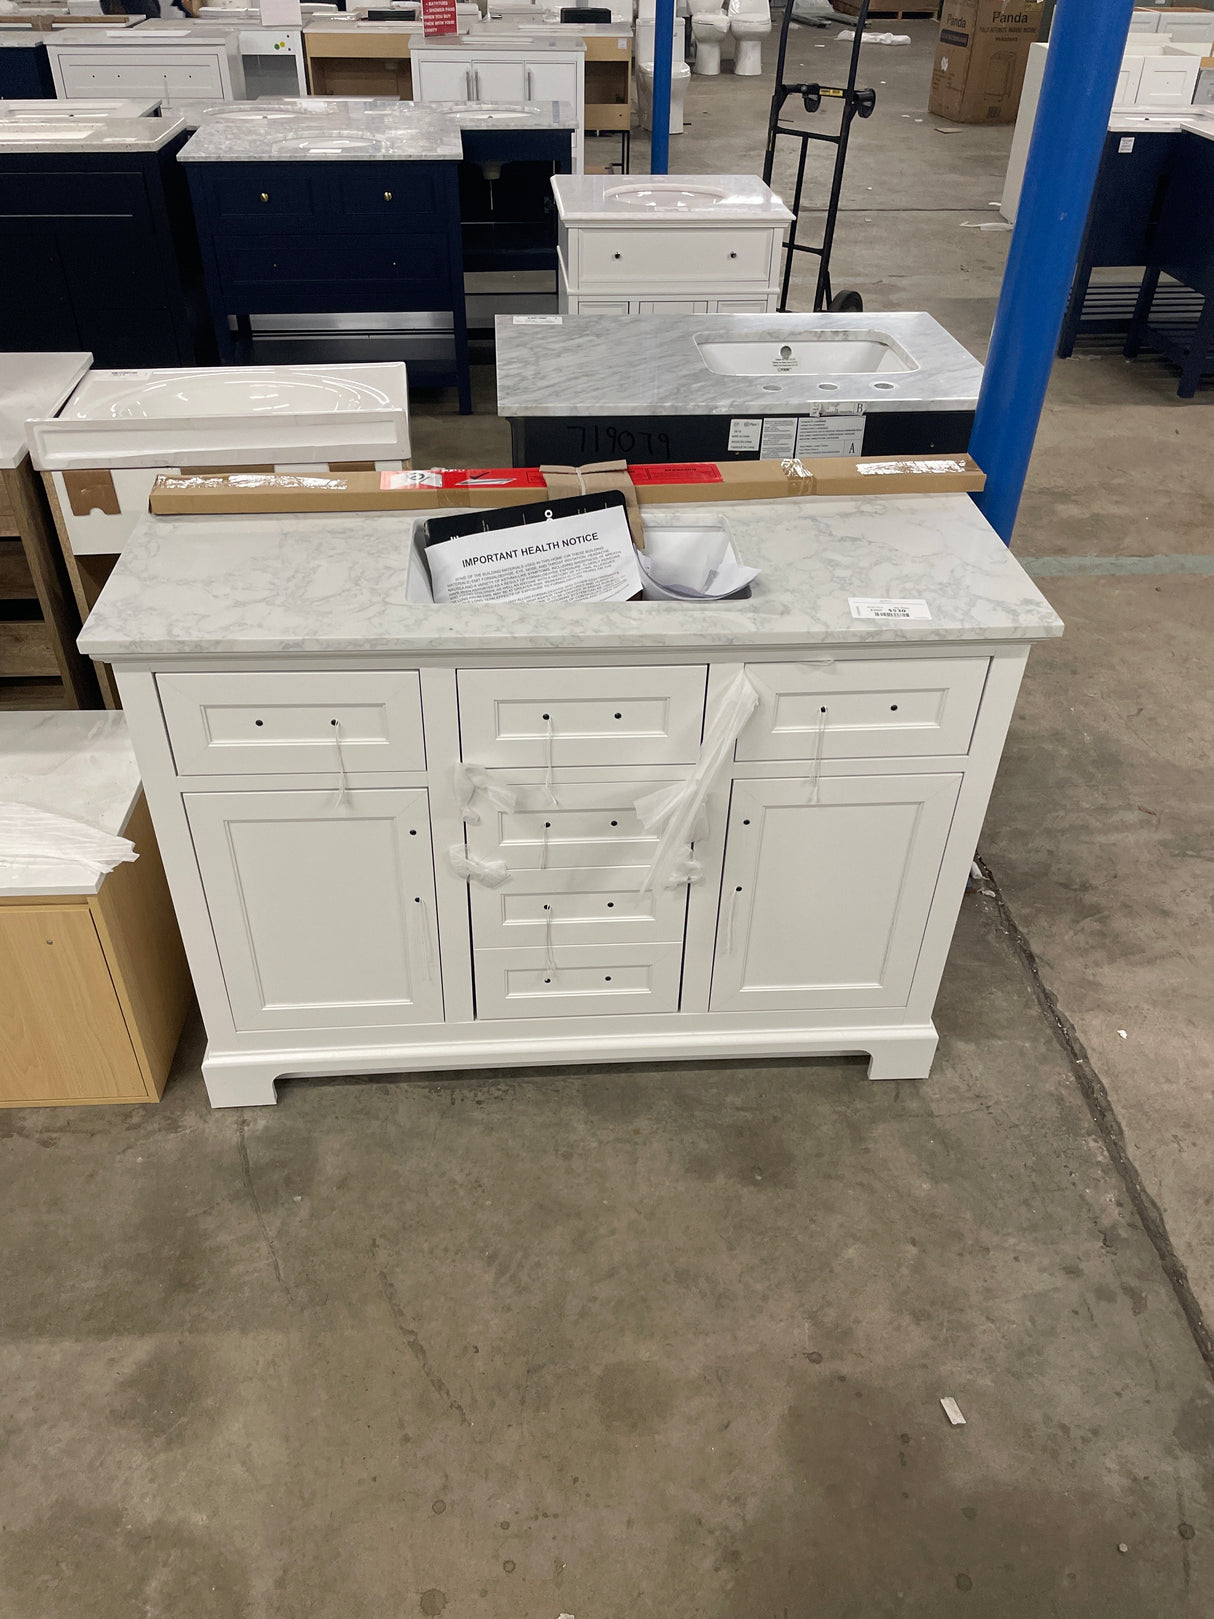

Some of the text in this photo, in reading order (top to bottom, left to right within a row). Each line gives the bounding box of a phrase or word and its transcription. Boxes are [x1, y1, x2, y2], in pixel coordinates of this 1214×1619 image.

[947, 14, 966, 28] Panda
[992, 11, 1028, 23] Panda
[856, 403, 863, 414] B
[567, 424, 670, 460] 719079
[848, 442, 856, 454] A
[462, 532, 598, 567] IMPORTANT HEALTH NOTICE
